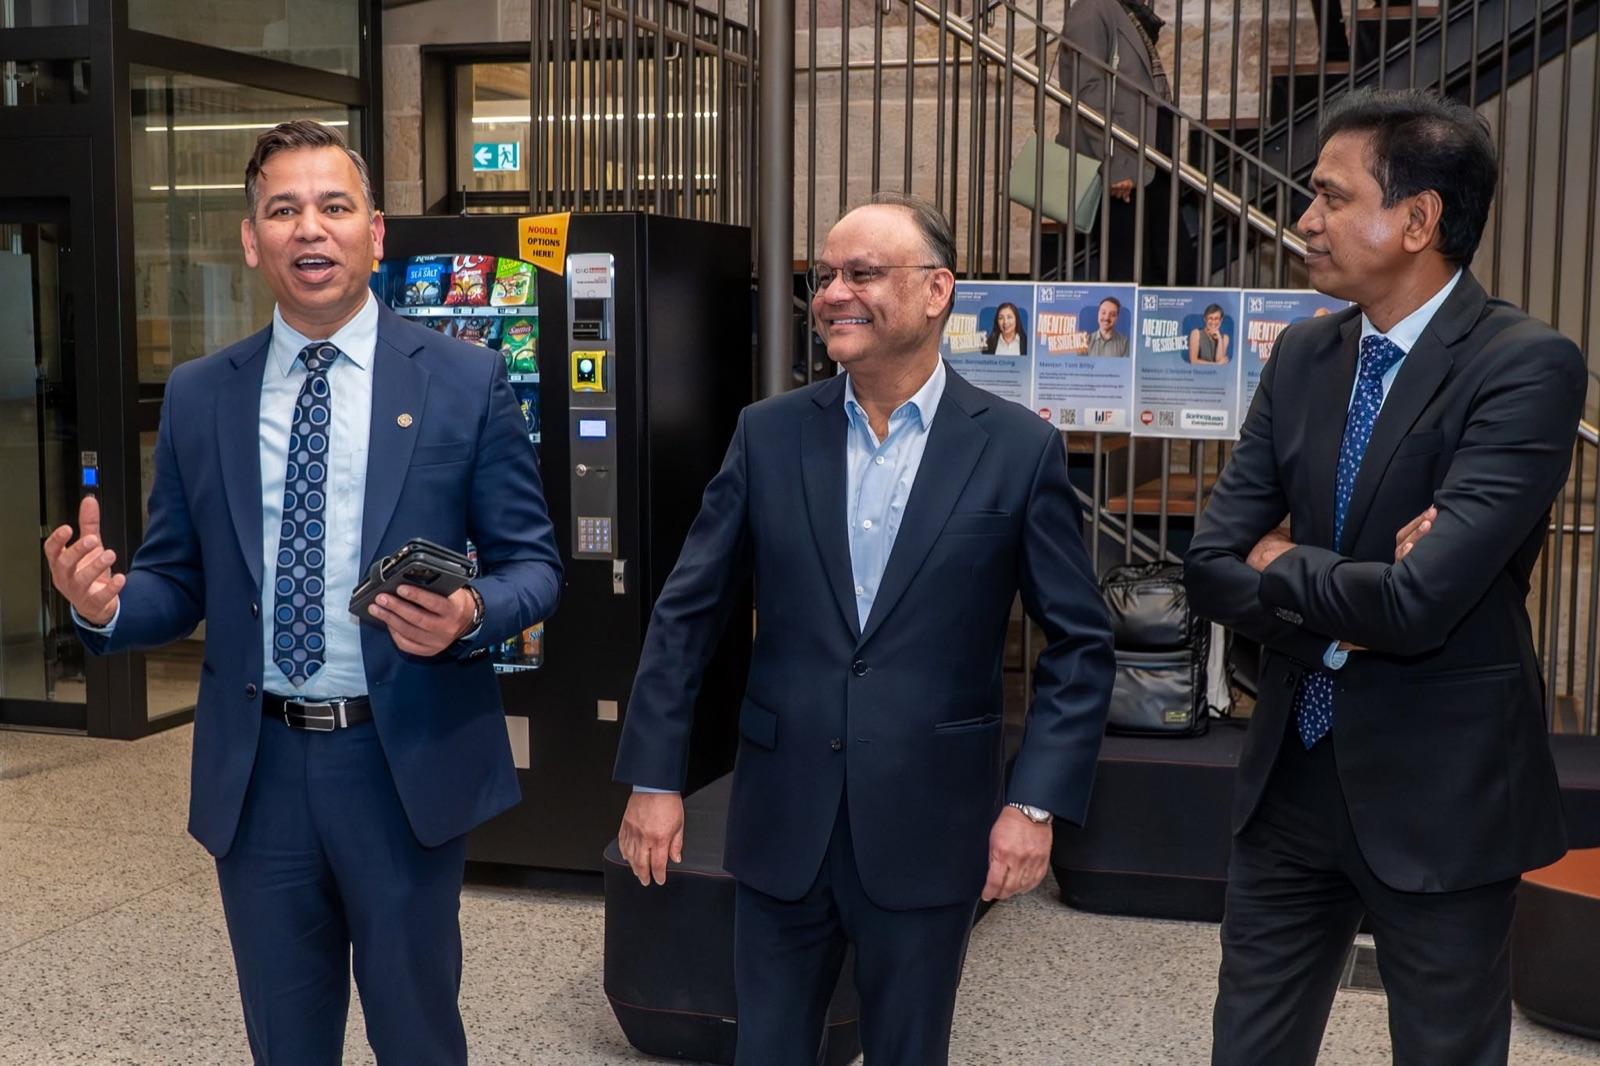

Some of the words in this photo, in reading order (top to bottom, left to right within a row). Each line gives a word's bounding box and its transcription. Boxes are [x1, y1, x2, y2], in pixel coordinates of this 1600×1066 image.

[528, 226, 558, 235] NOODLE
[527, 237, 560, 247] OPTIONS
[533, 249, 554, 258] HERE!
[410, 269, 423, 279] SEA
[423, 268, 438, 278] SALT
[946, 314, 977, 335] ENTOR
[1038, 313, 1077, 335] MENTOR
[1142, 319, 1178, 337] MENTOR
[1248, 320, 1287, 340] MENTO
[1048, 331, 1089, 352] RESIDENCE
[1152, 335, 1189, 352] RESIDENCE
